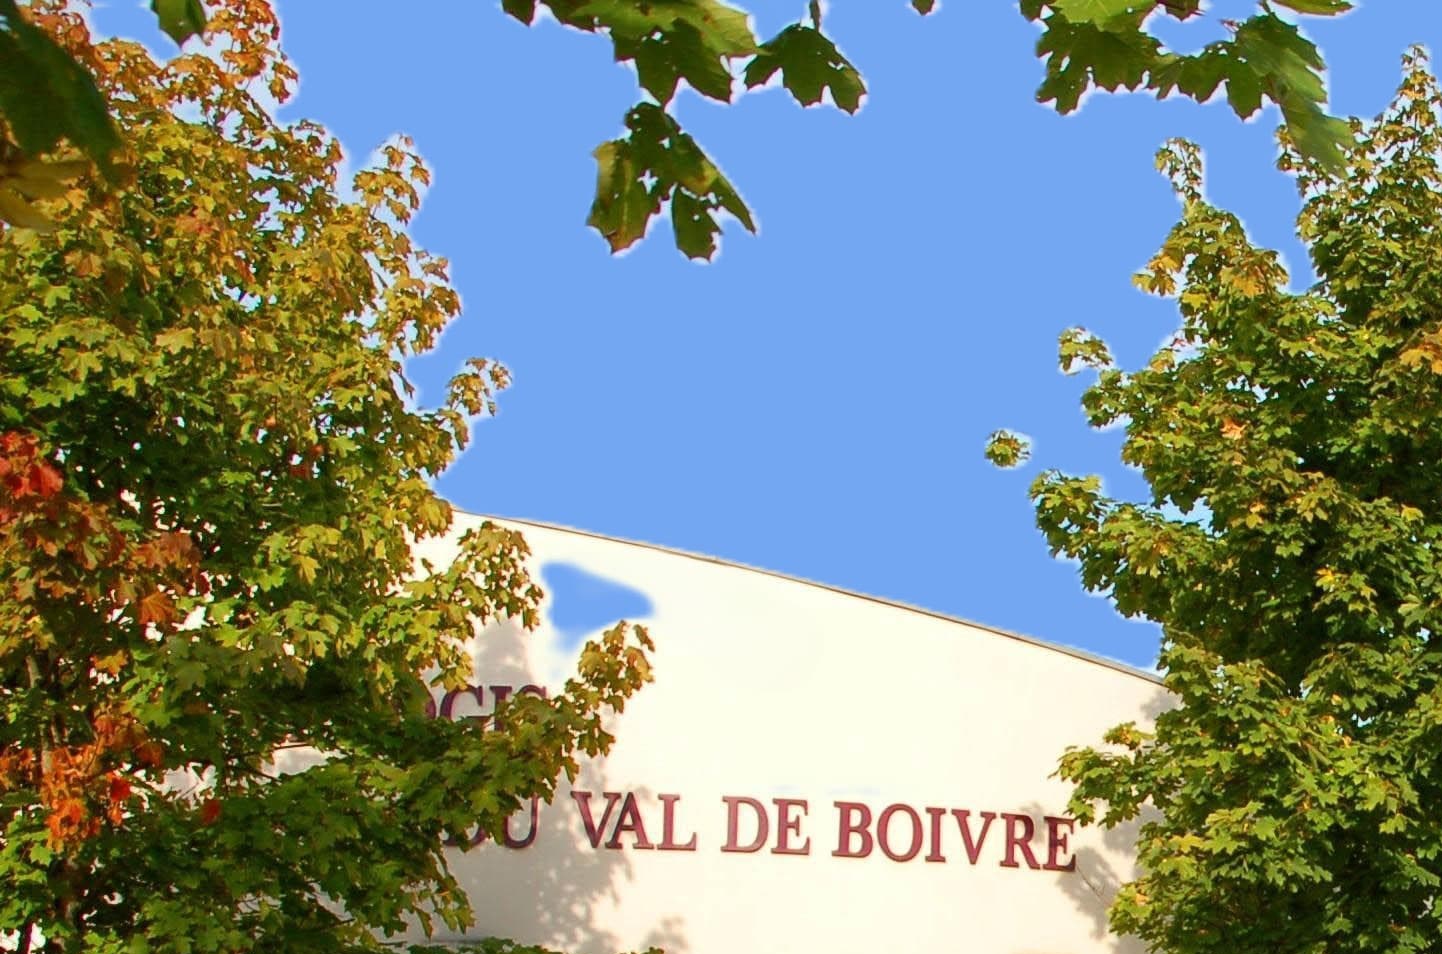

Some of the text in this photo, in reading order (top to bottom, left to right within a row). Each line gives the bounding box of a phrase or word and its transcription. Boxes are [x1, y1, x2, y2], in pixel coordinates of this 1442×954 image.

[443, 790, 1077, 873] U VAL DE BOIVRE
